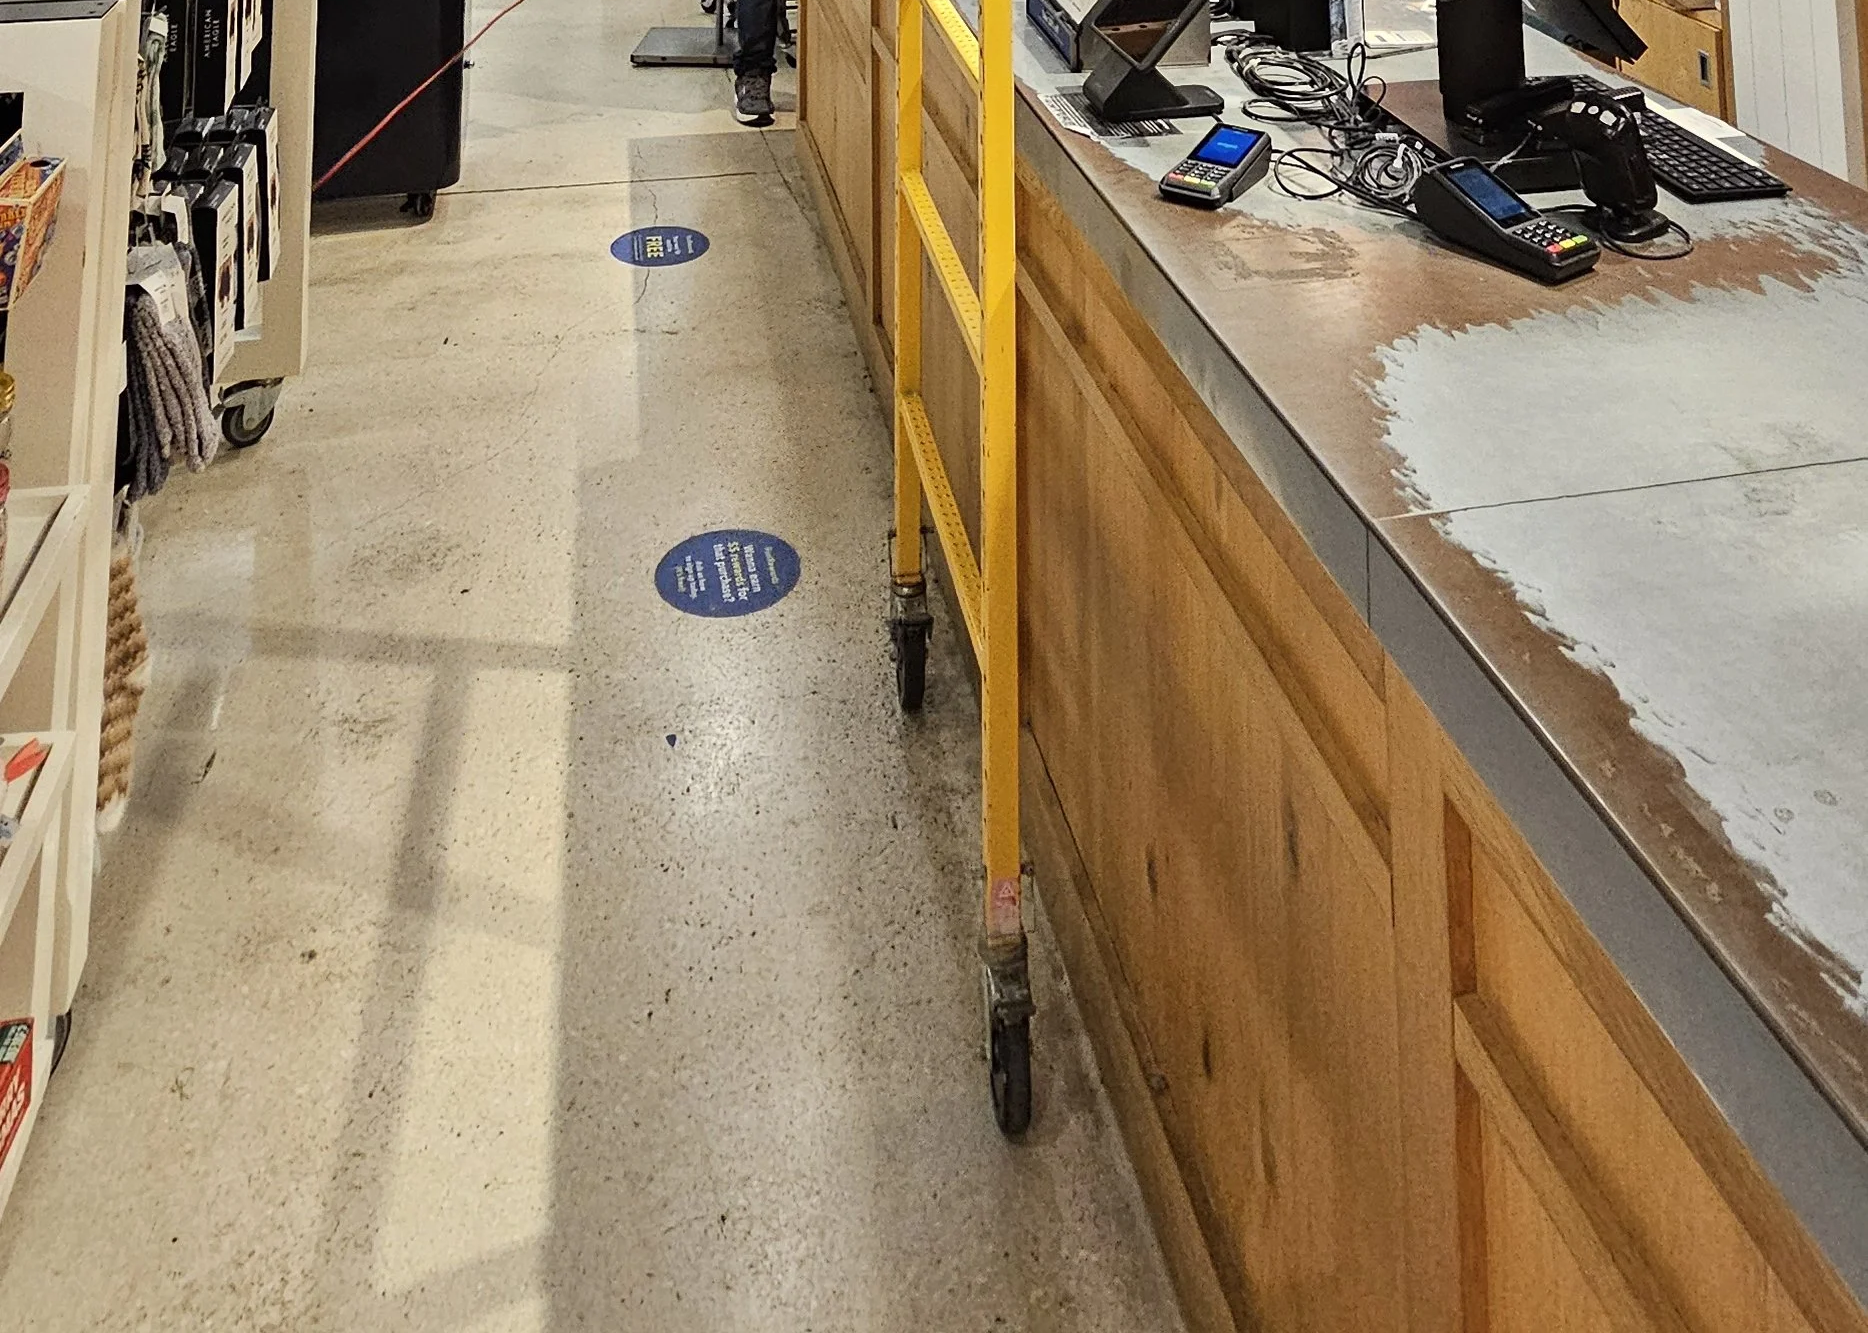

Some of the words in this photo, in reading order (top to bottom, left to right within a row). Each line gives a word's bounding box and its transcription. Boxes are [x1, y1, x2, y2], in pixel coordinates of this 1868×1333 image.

[170, 24, 178, 52] EAGLE
[204, 9, 212, 58] AMERICAN
[212, 19, 220, 47] EAGLE
[646, 236, 663, 258] FREE
[713, 544, 725, 560] that
[744, 544, 756, 572] Wanna
[714, 561, 735, 602] purchase?
[730, 553, 746, 586] rewards
[749, 574, 761, 592] earn
[737, 587, 749, 600] for
